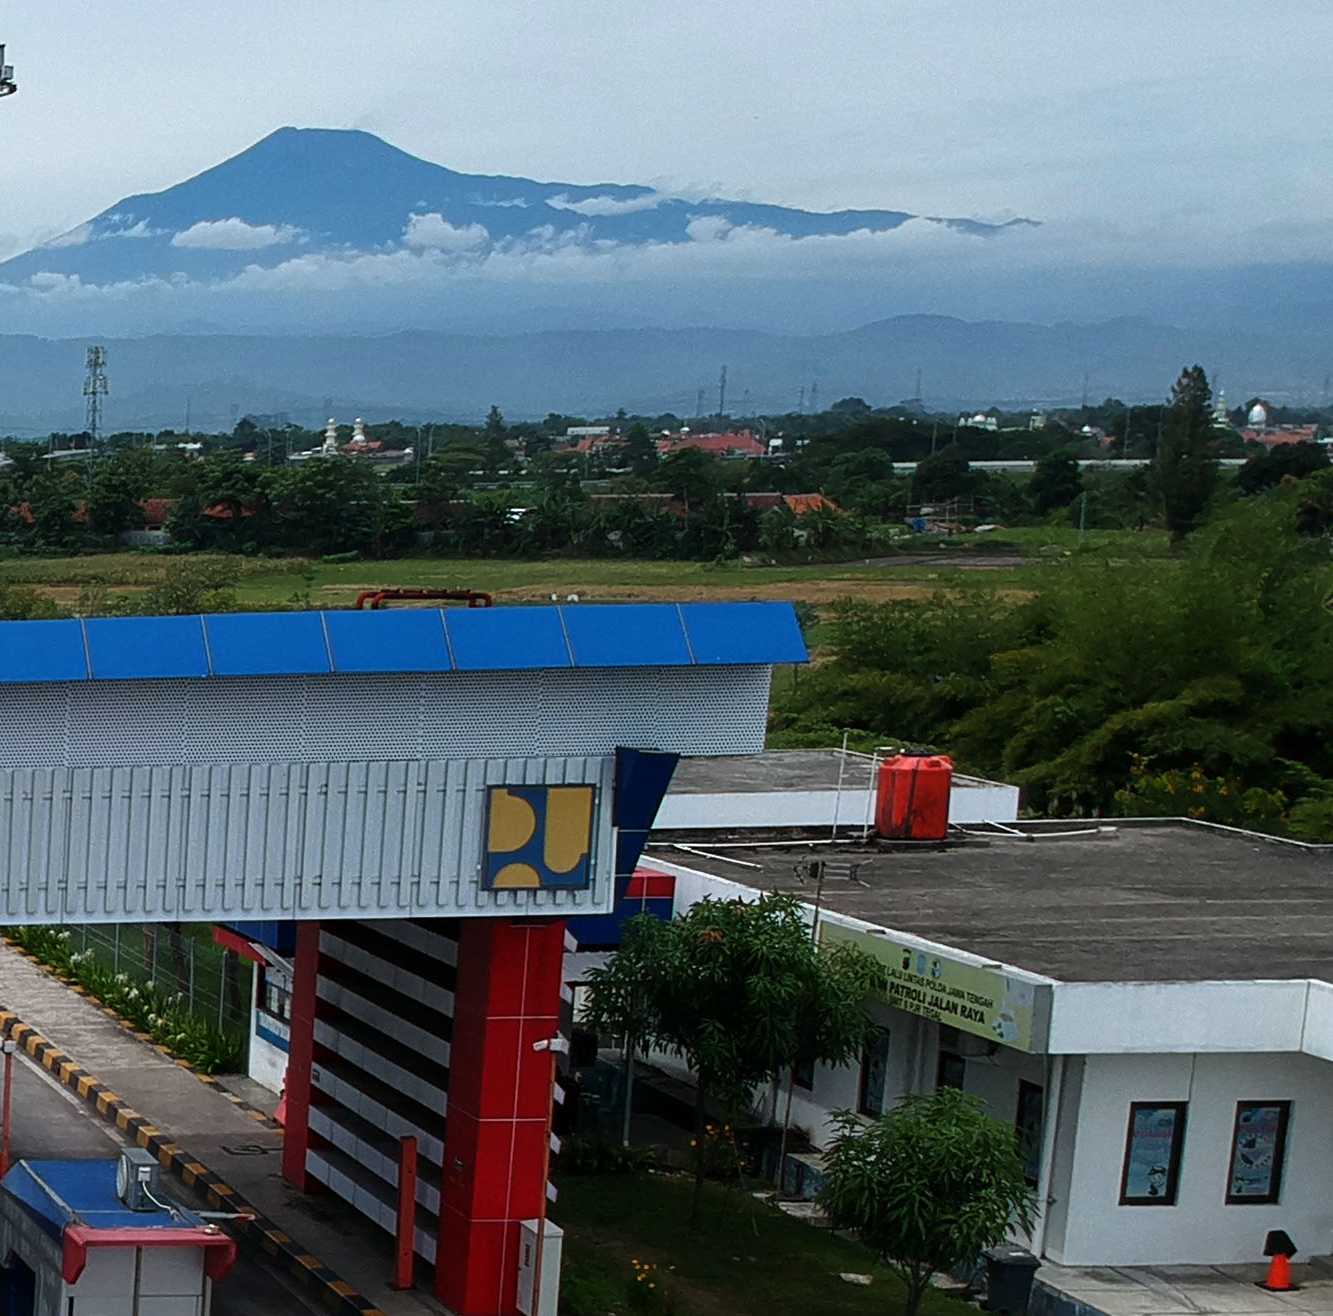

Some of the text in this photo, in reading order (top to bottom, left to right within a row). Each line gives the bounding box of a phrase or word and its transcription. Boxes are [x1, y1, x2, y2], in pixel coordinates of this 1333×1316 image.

[889, 981, 985, 1024] PATROLI JALAN RAYA
[903, 971, 925, 987] LINTAS
[925, 977, 947, 993] POLDA
[948, 986, 965, 1000] JAWA
[966, 992, 993, 1009] TENGAH
